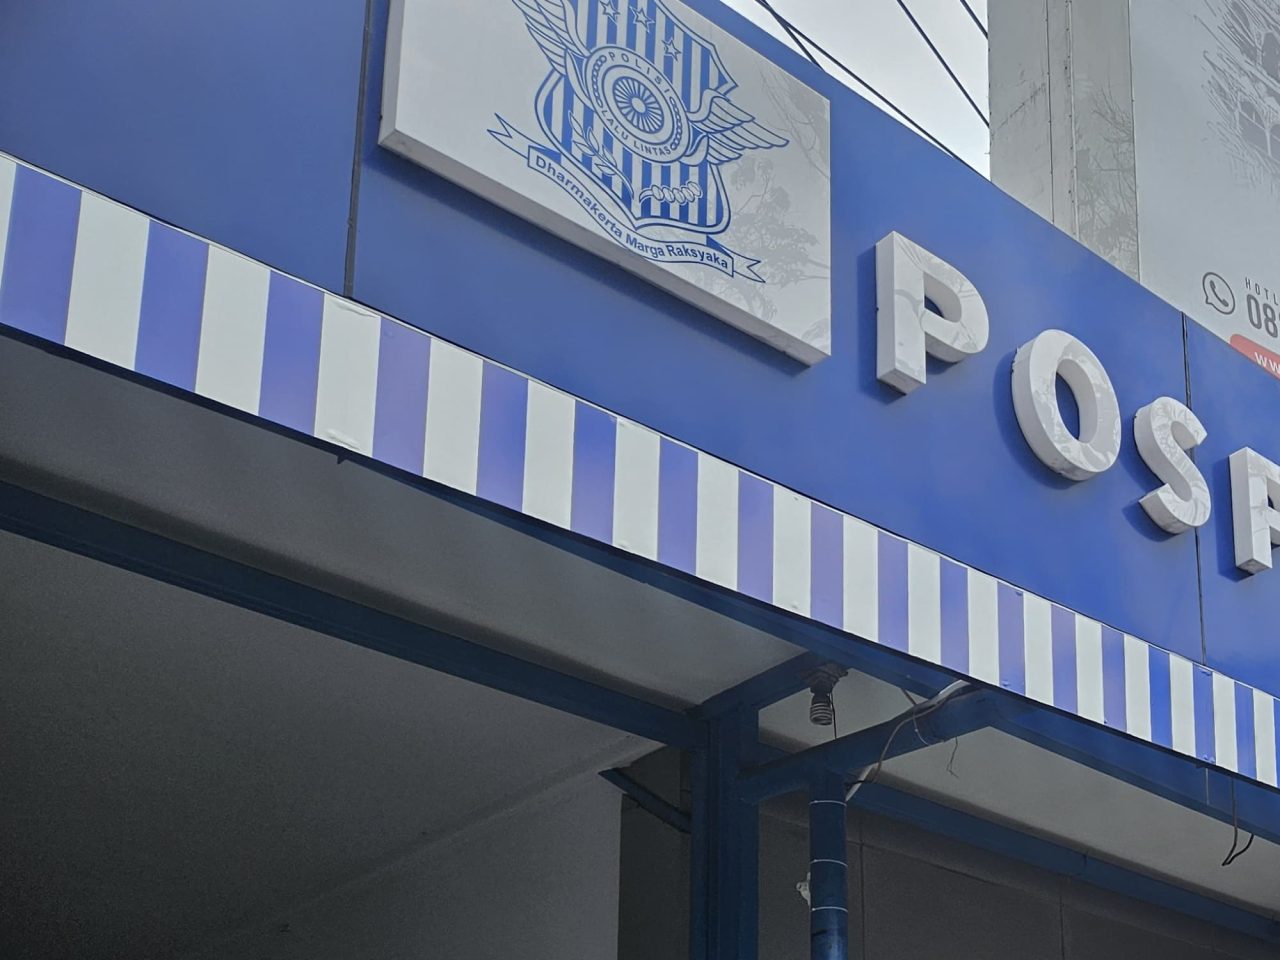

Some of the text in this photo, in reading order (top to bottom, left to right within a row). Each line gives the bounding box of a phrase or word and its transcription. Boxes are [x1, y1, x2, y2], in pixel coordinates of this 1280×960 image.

[608, 51, 671, 94] POLISI
[601, 109, 671, 157] LALU LINTAS
[535, 154, 728, 270] Dharmakerta Marga Raksyaka
[876, 230, 1212, 535] POS
